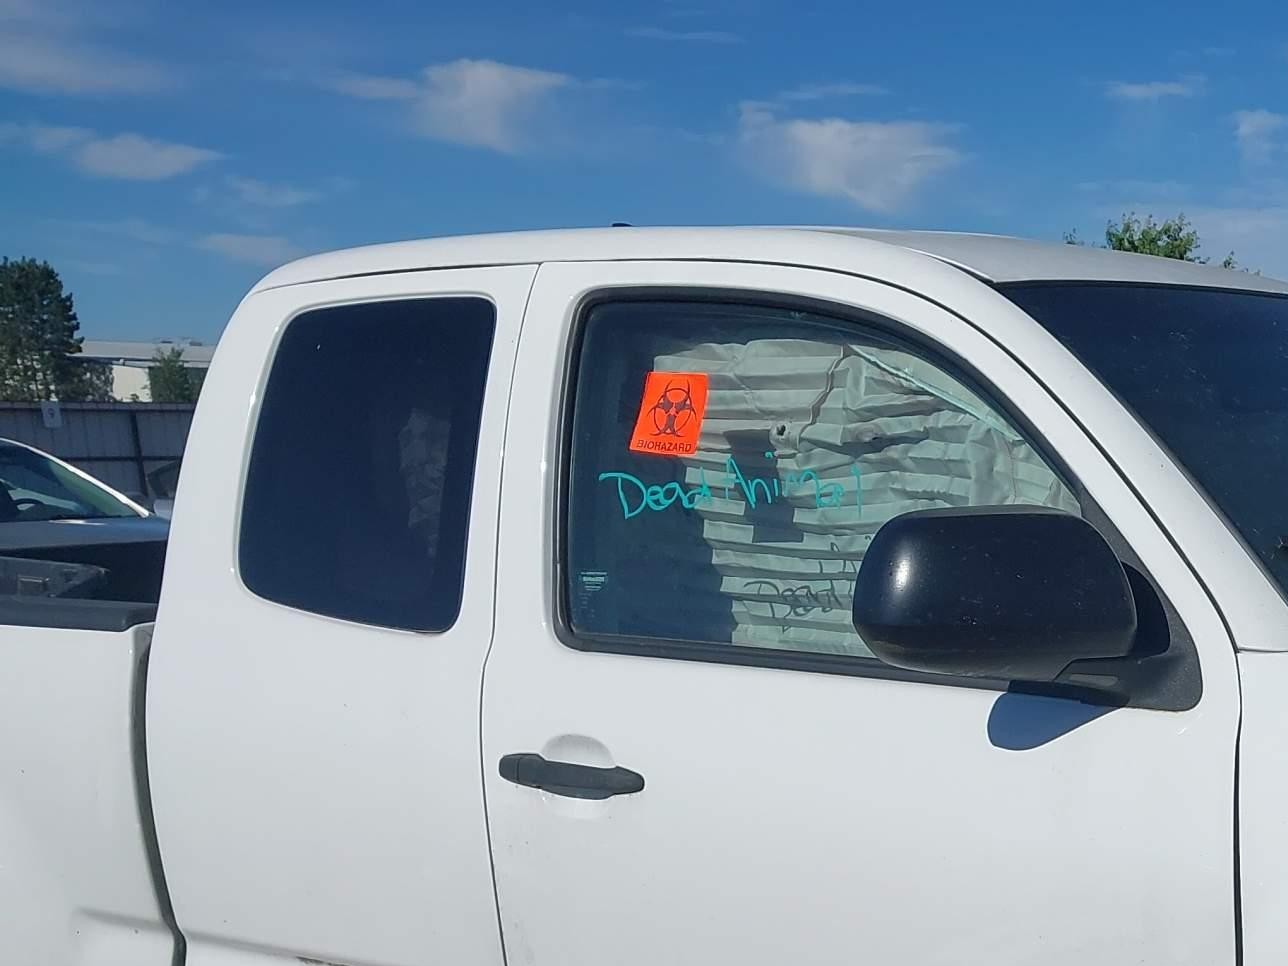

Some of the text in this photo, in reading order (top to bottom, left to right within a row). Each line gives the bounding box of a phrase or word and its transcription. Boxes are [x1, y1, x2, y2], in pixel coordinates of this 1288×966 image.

[637, 439, 692, 452] BIOHAZARD
[598, 451, 864, 520] Dead Animal
